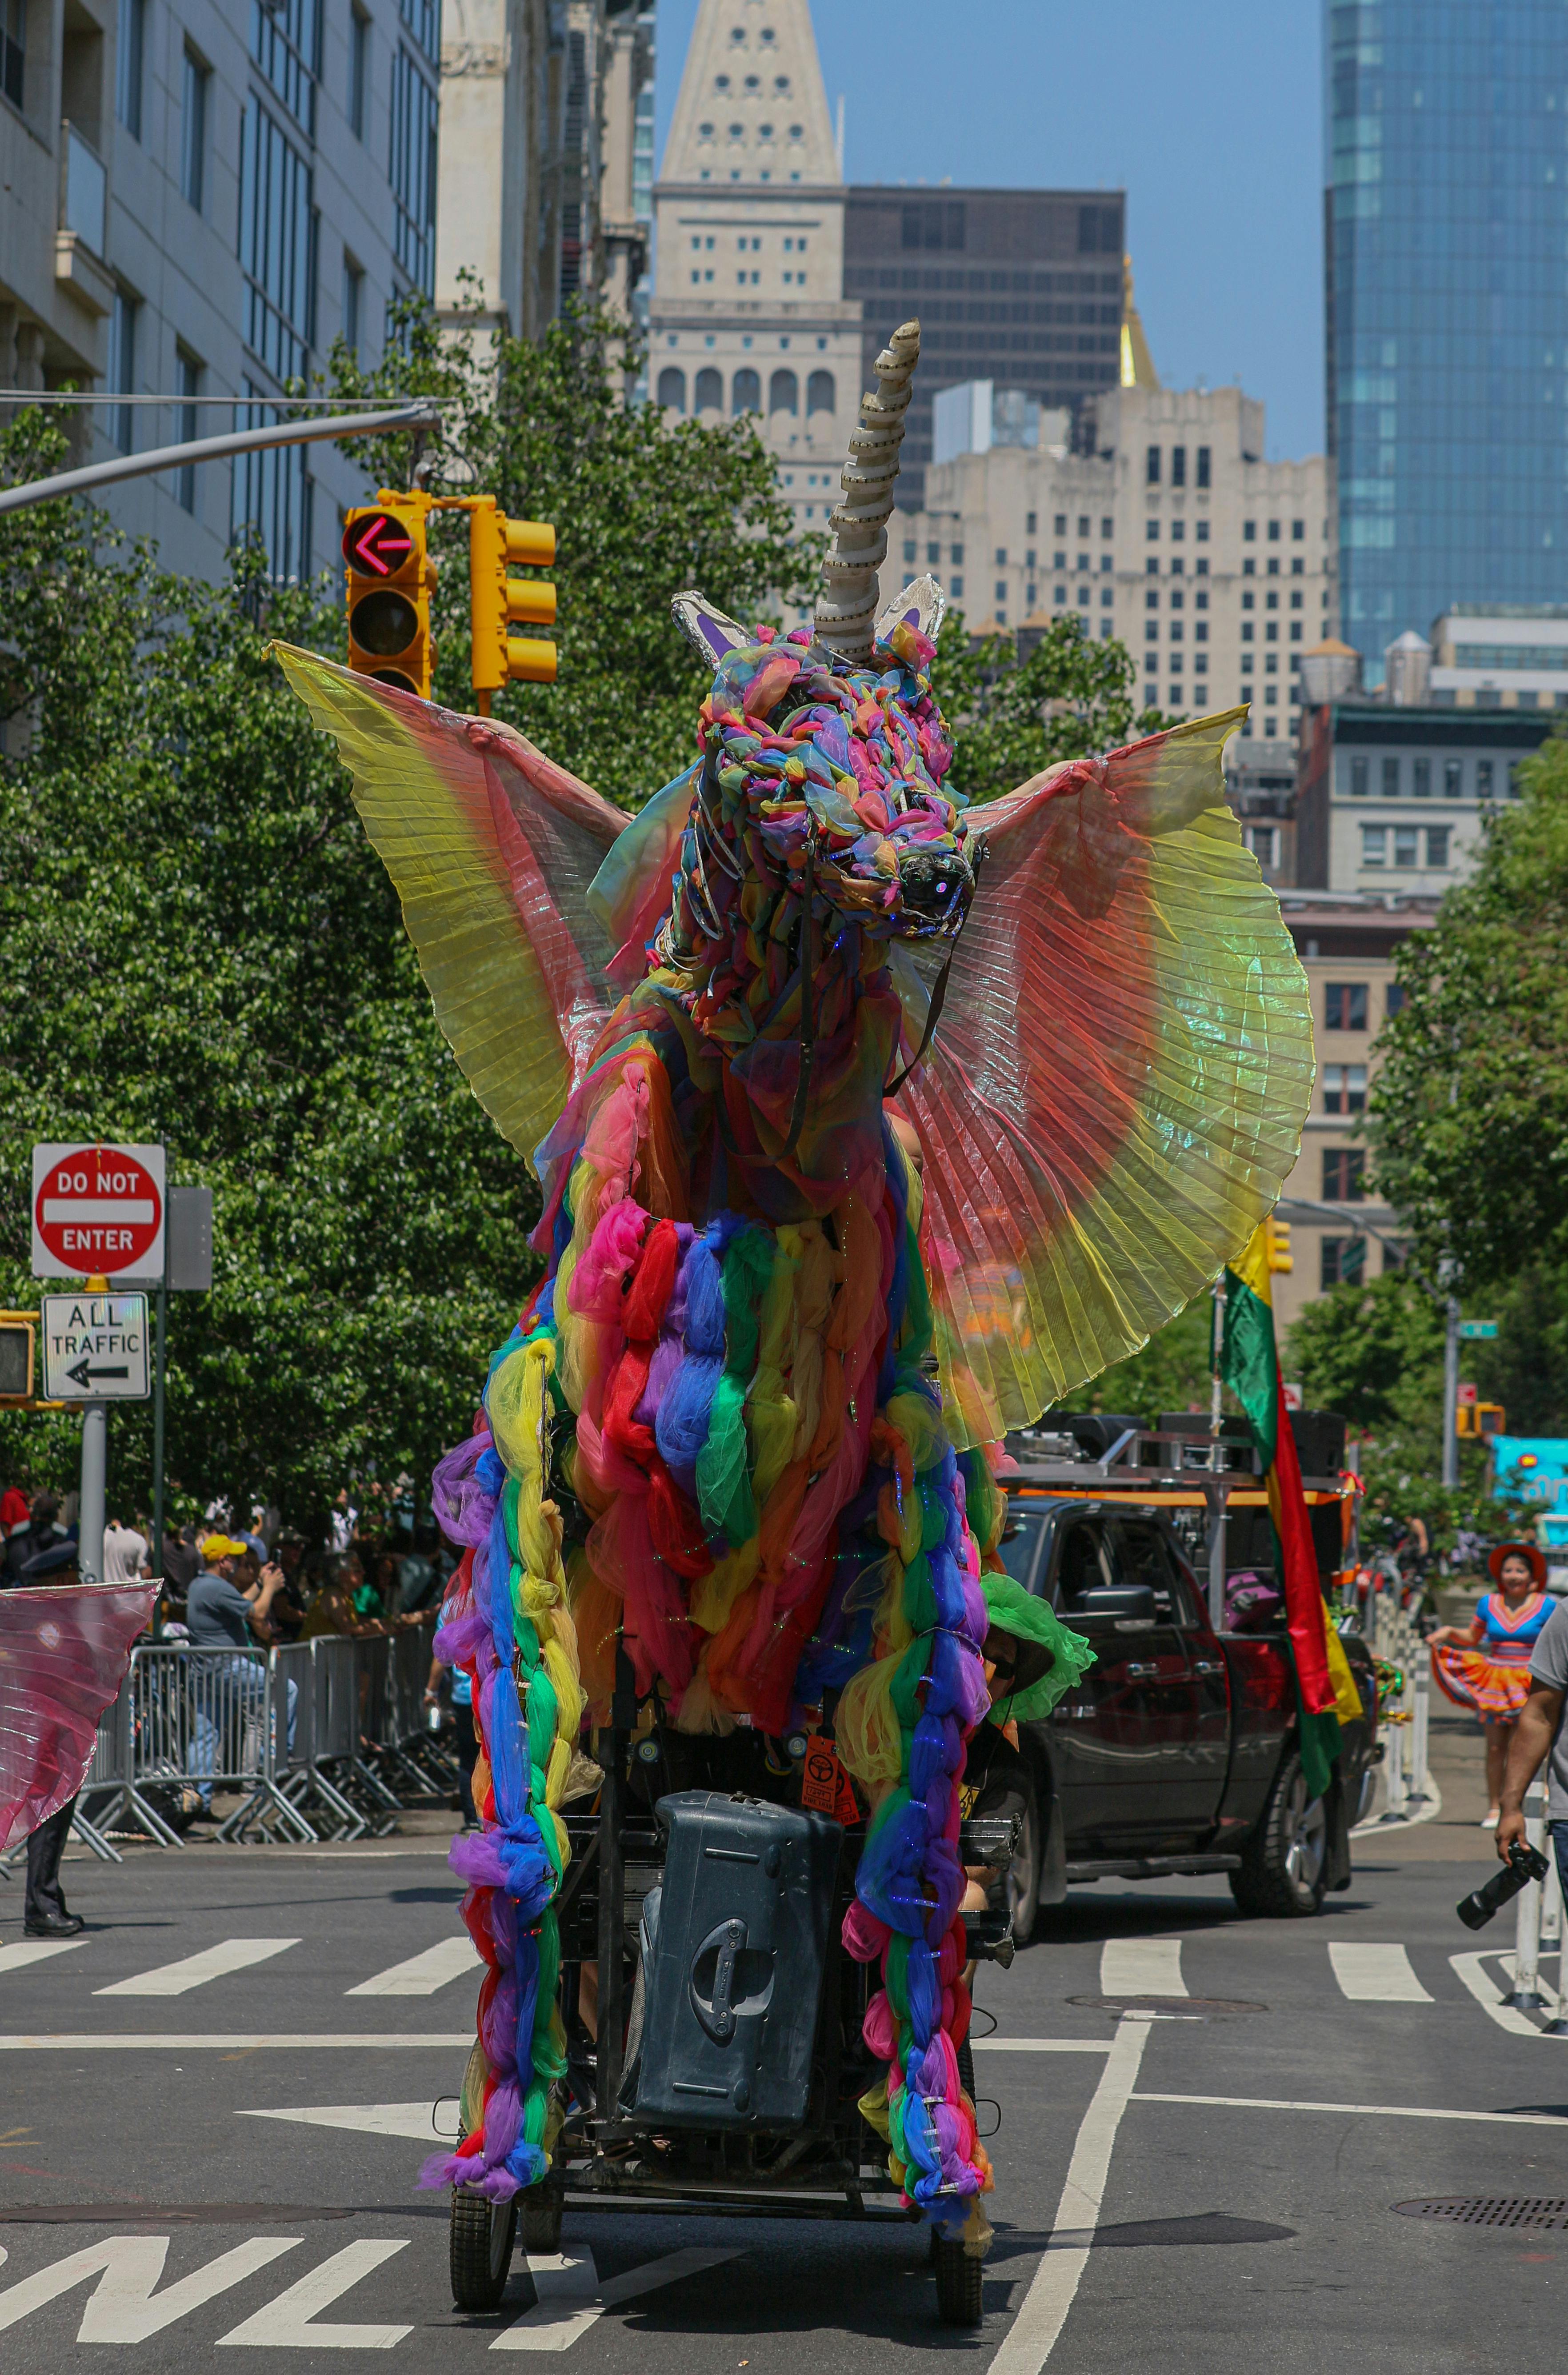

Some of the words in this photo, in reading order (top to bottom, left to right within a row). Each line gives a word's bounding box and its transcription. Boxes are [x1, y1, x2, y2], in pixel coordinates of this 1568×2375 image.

[58, 1172, 88, 1193] DO
[96, 1172, 139, 1193] NOT
[63, 1230, 133, 1250] ENTER
[68, 1305, 123, 1327] ALL
[52, 1334, 139, 1354] TRAFFIC
[0, 2236, 751, 2351] NLY
